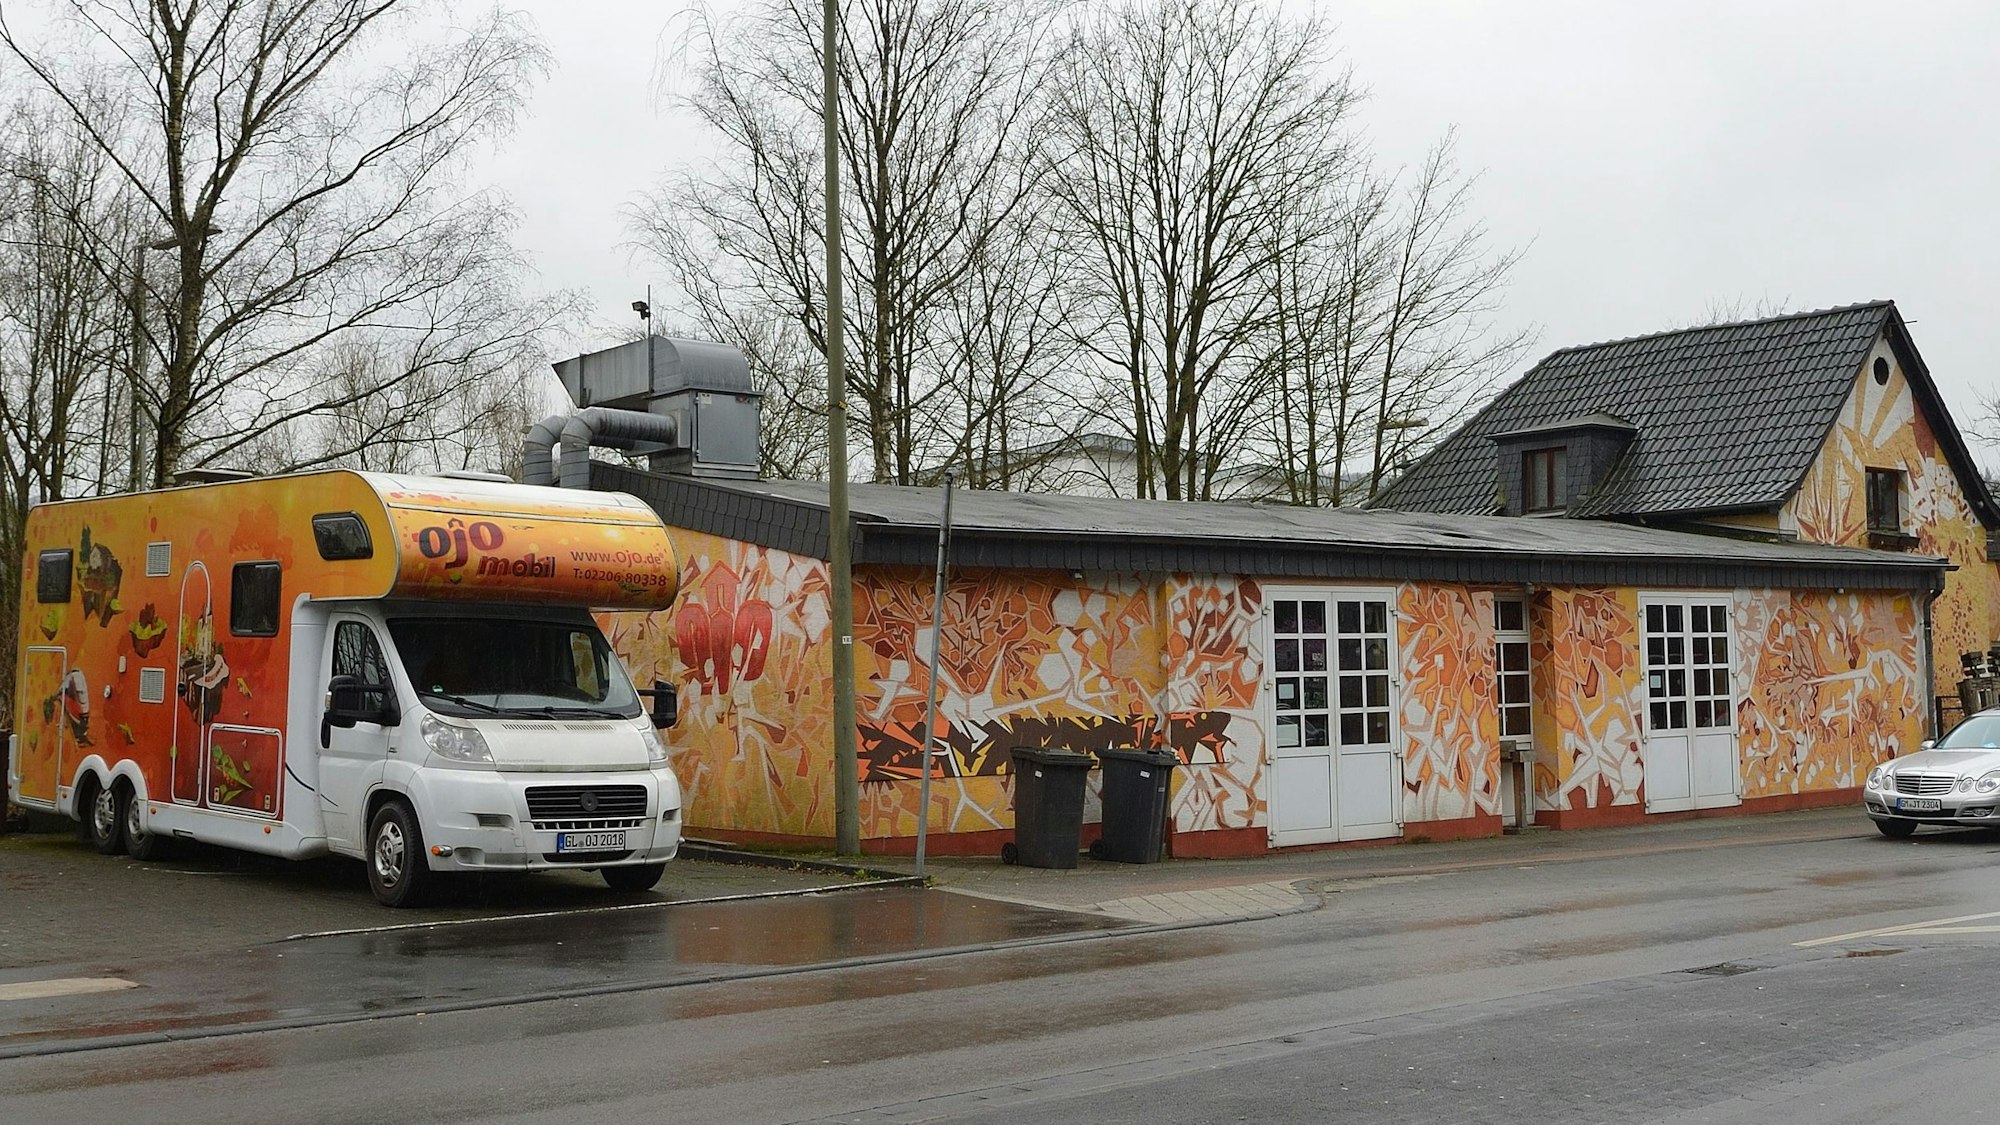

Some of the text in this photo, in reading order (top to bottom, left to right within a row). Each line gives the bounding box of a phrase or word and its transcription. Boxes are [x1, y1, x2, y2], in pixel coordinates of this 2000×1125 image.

[476, 552, 556, 578] mobil
[625, 572, 668, 587] 80338
[565, 833, 624, 848] GL OJ 2018
